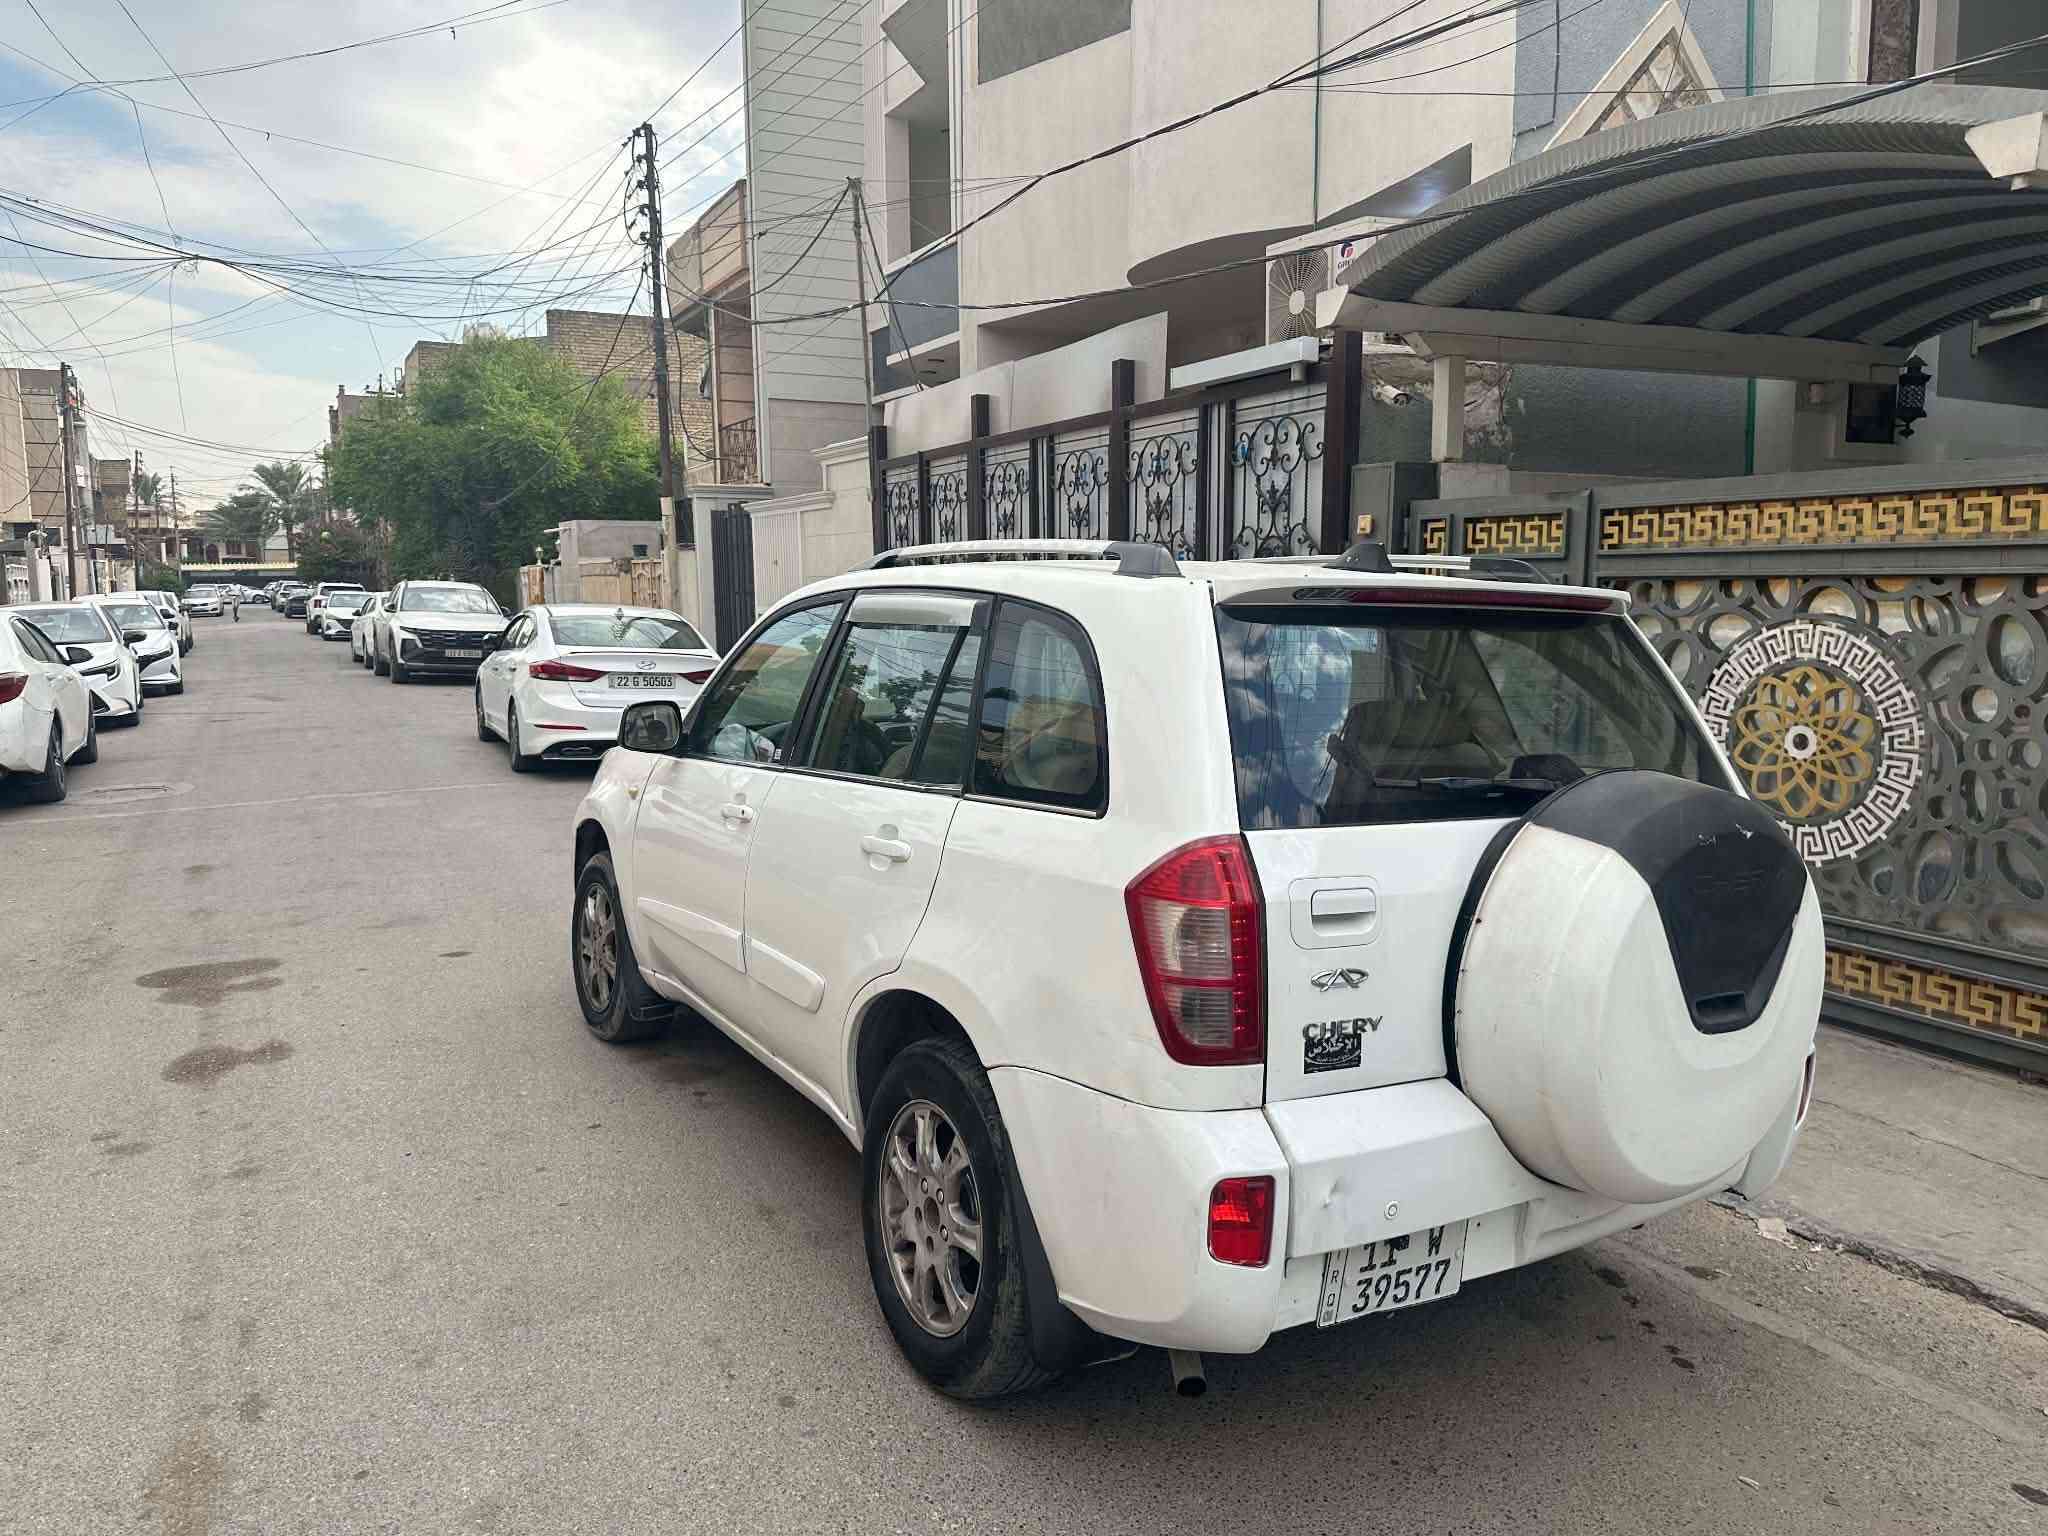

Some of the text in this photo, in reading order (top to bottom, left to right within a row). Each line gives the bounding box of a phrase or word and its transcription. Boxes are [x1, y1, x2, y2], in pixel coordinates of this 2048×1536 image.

[616, 676, 673, 687] 22 G 50503
[1302, 1015, 1383, 1040] CHERY
[1428, 1225, 1445, 1257] W
[1351, 1257, 1451, 1313] 39577
